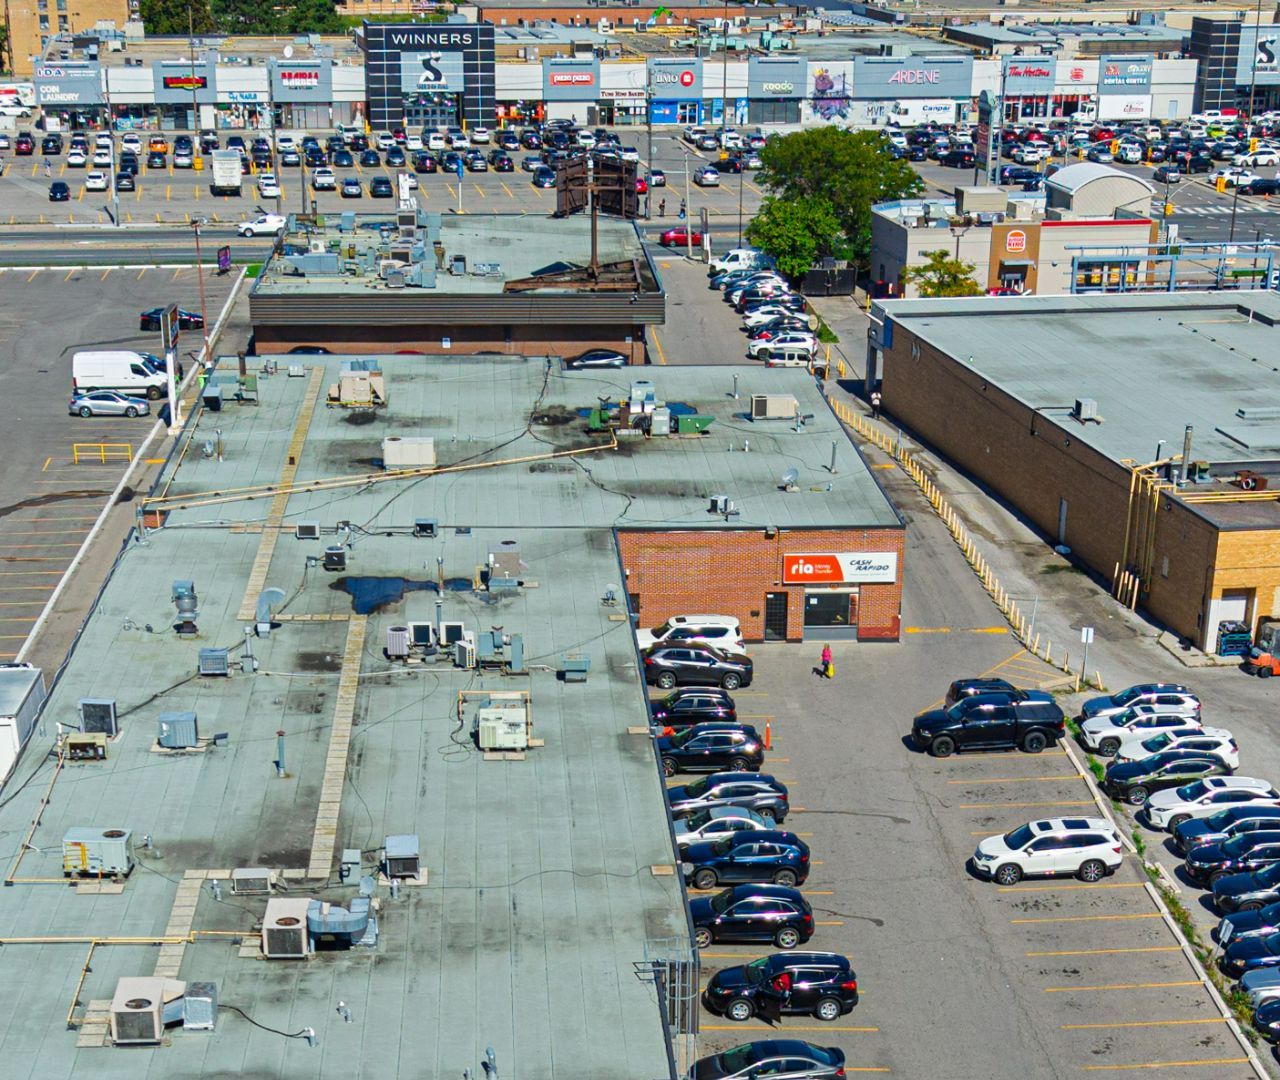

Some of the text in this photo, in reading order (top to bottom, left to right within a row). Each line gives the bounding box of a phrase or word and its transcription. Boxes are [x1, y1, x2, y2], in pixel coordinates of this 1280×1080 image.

[391, 33, 472, 45] WINNERS
[888, 69, 940, 85] ARDENE
[40, 85, 59, 93] COIN
[40, 92, 80, 101] LAUNDRY
[791, 559, 814, 575] ria
